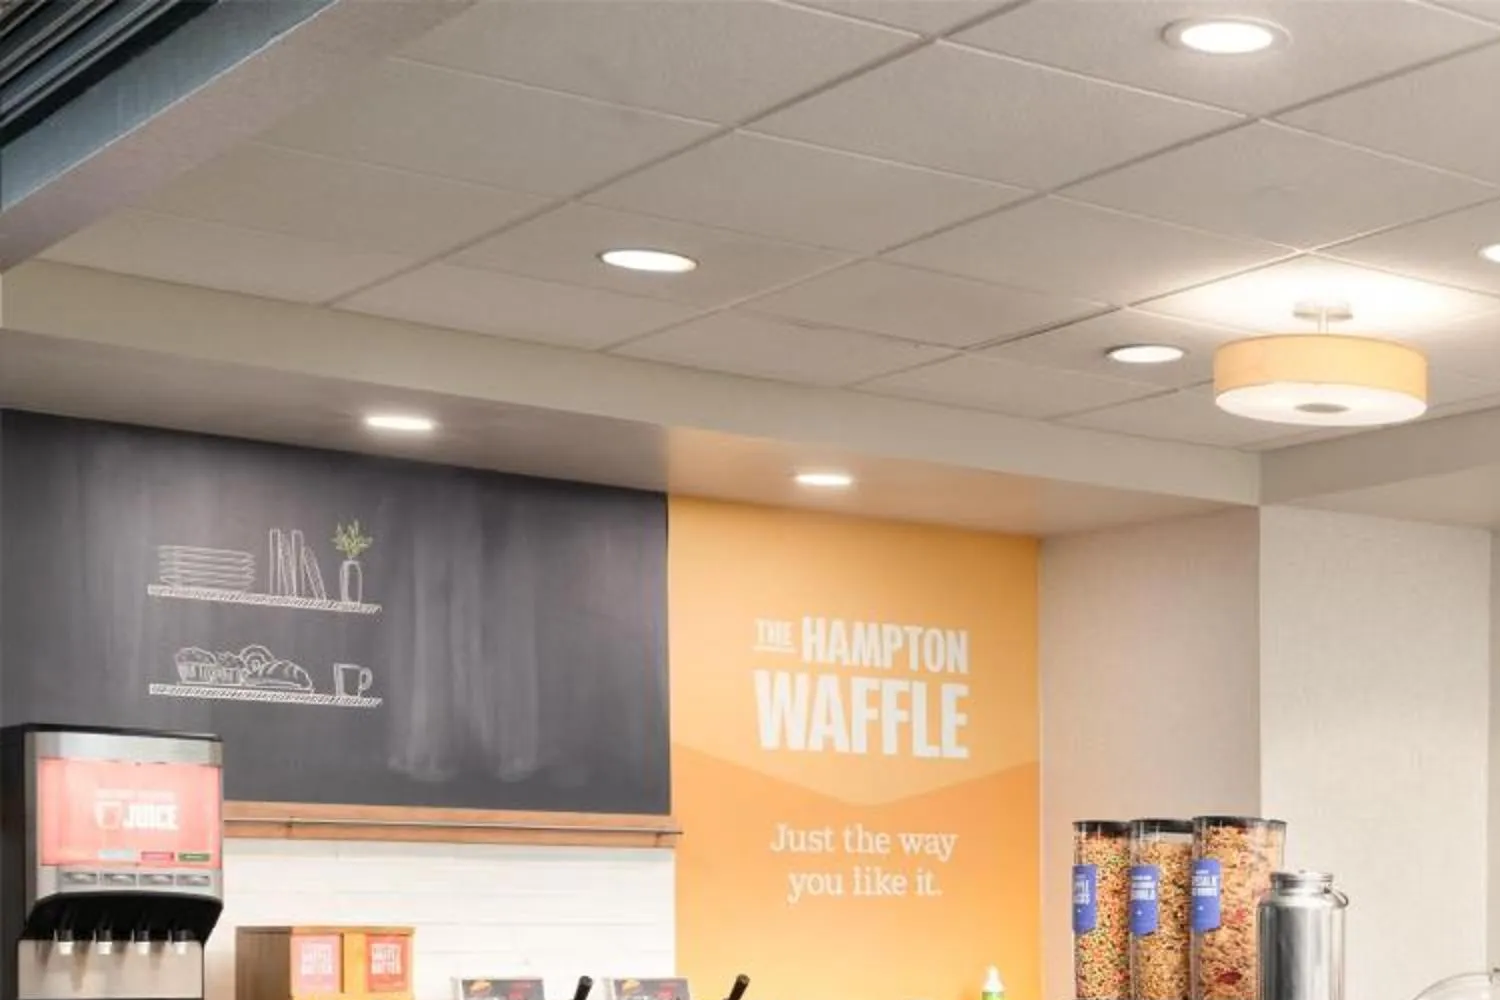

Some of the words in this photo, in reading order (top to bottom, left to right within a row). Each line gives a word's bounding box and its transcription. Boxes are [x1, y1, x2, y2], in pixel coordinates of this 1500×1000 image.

[755, 619, 793, 646] THE
[802, 616, 969, 673] HAMPTON
[754, 669, 969, 759] WAFFLE
[122, 804, 179, 830] JUICE
[771, 823, 834, 852] Just
[843, 824, 890, 853] the
[898, 832, 958, 862] way
[787, 871, 842, 904] you
[853, 866, 907, 896] like
[917, 868, 942, 896] it.
